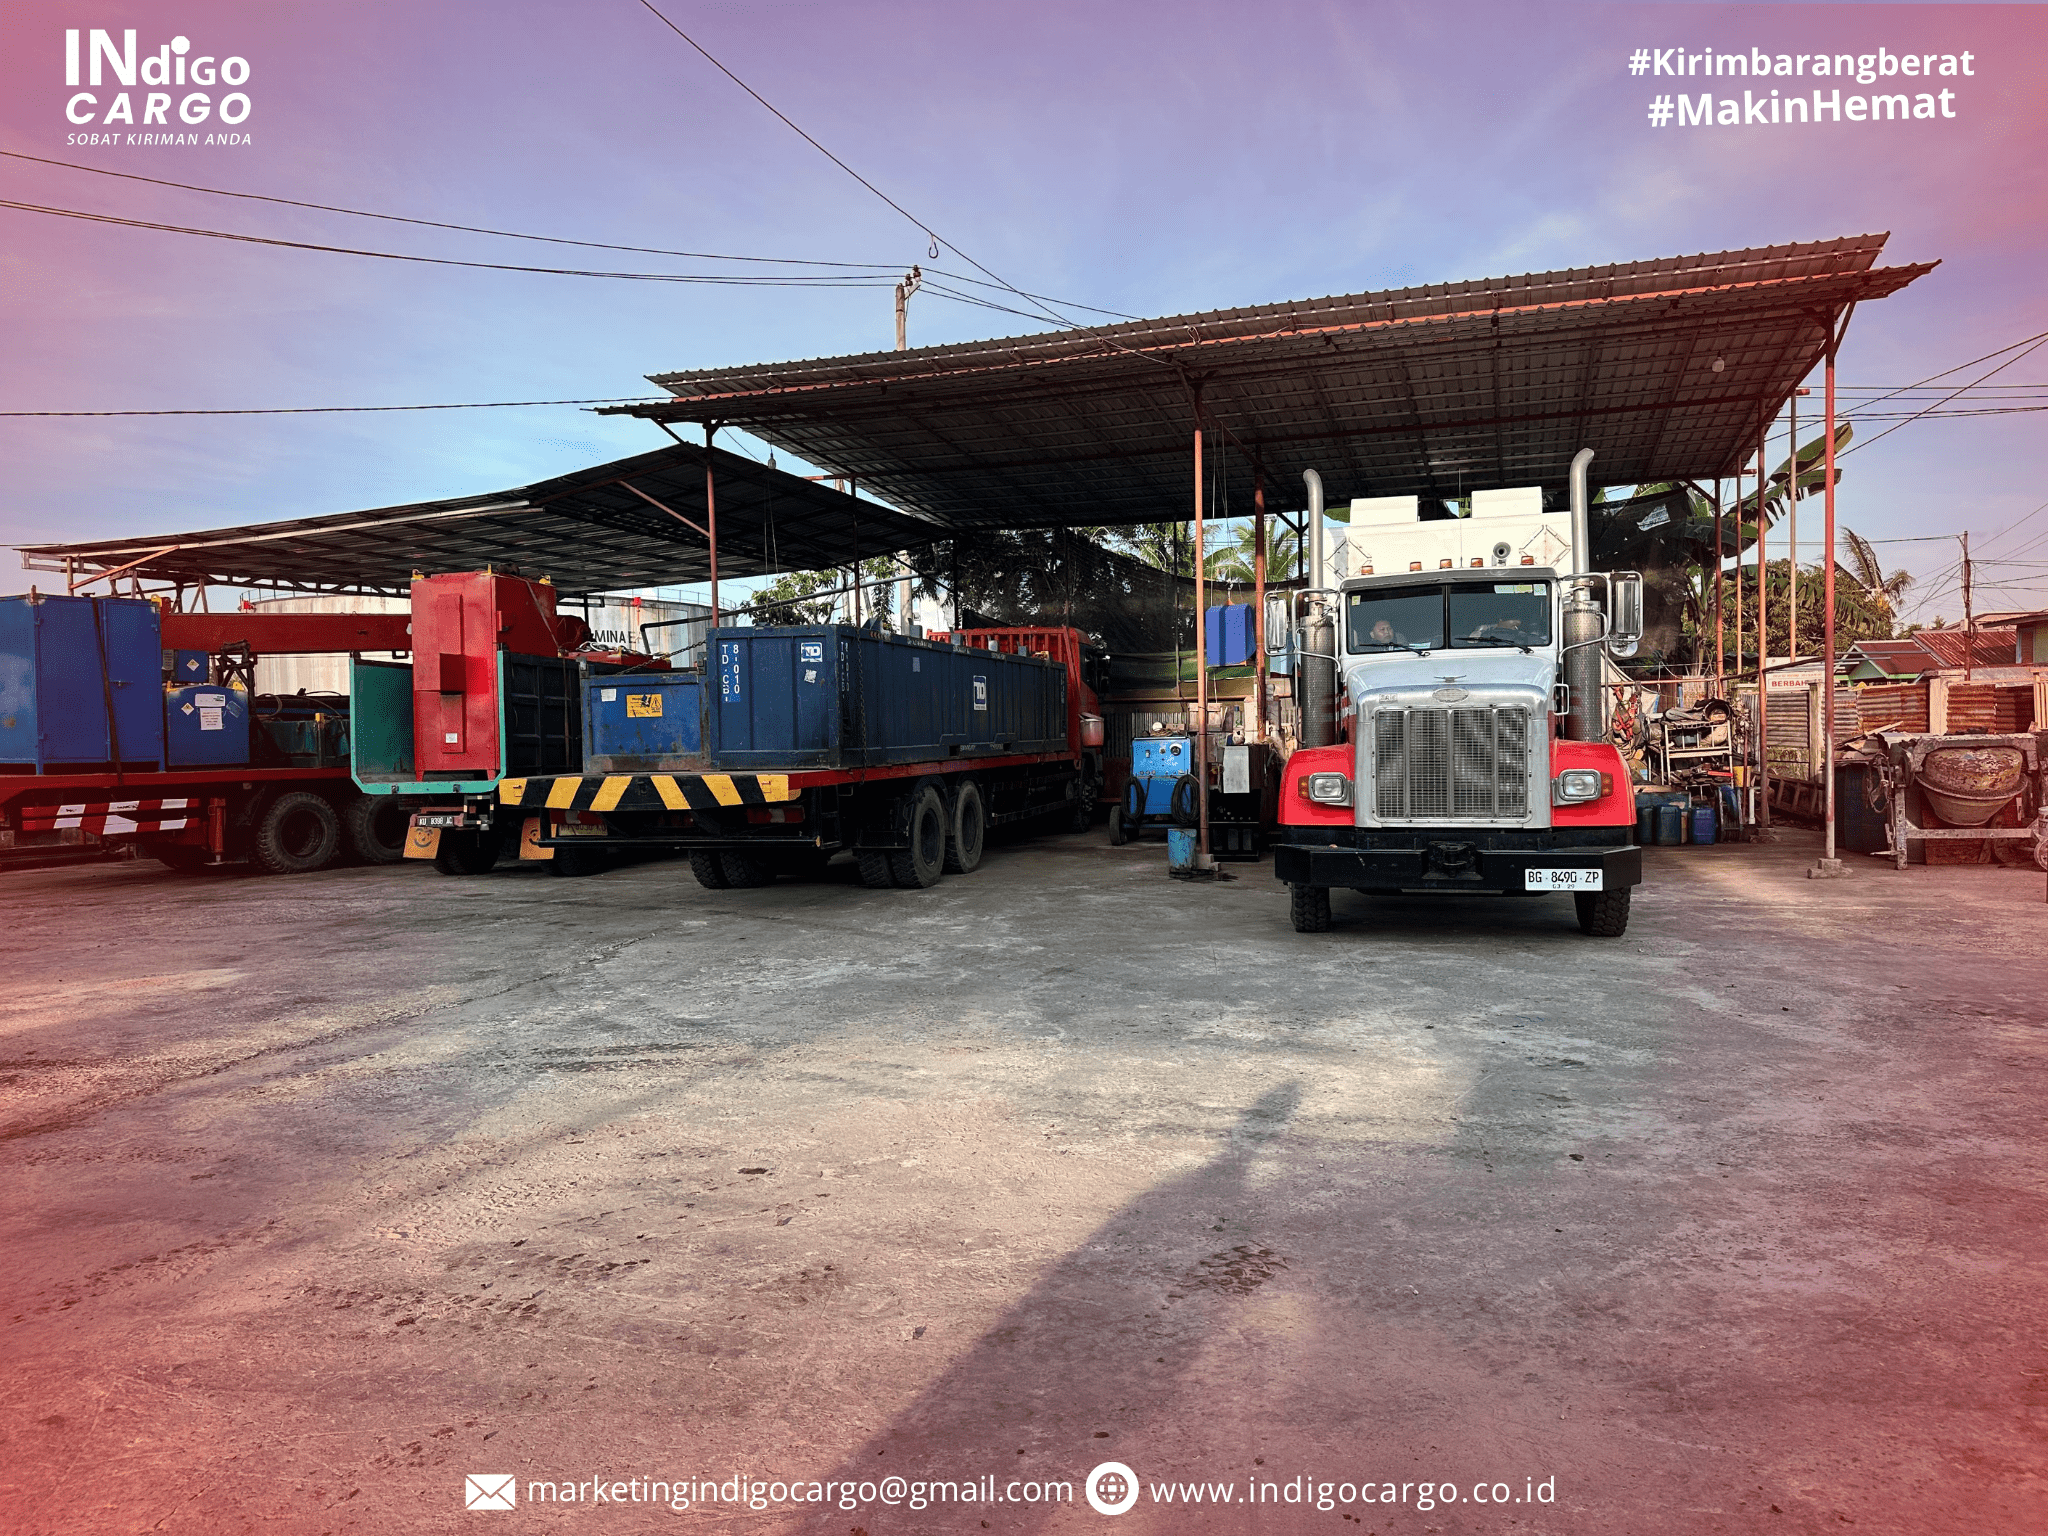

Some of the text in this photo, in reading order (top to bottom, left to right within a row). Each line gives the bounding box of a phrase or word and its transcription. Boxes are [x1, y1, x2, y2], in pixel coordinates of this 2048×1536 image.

[1528, 871, 1599, 883] BG 8490 ZP
